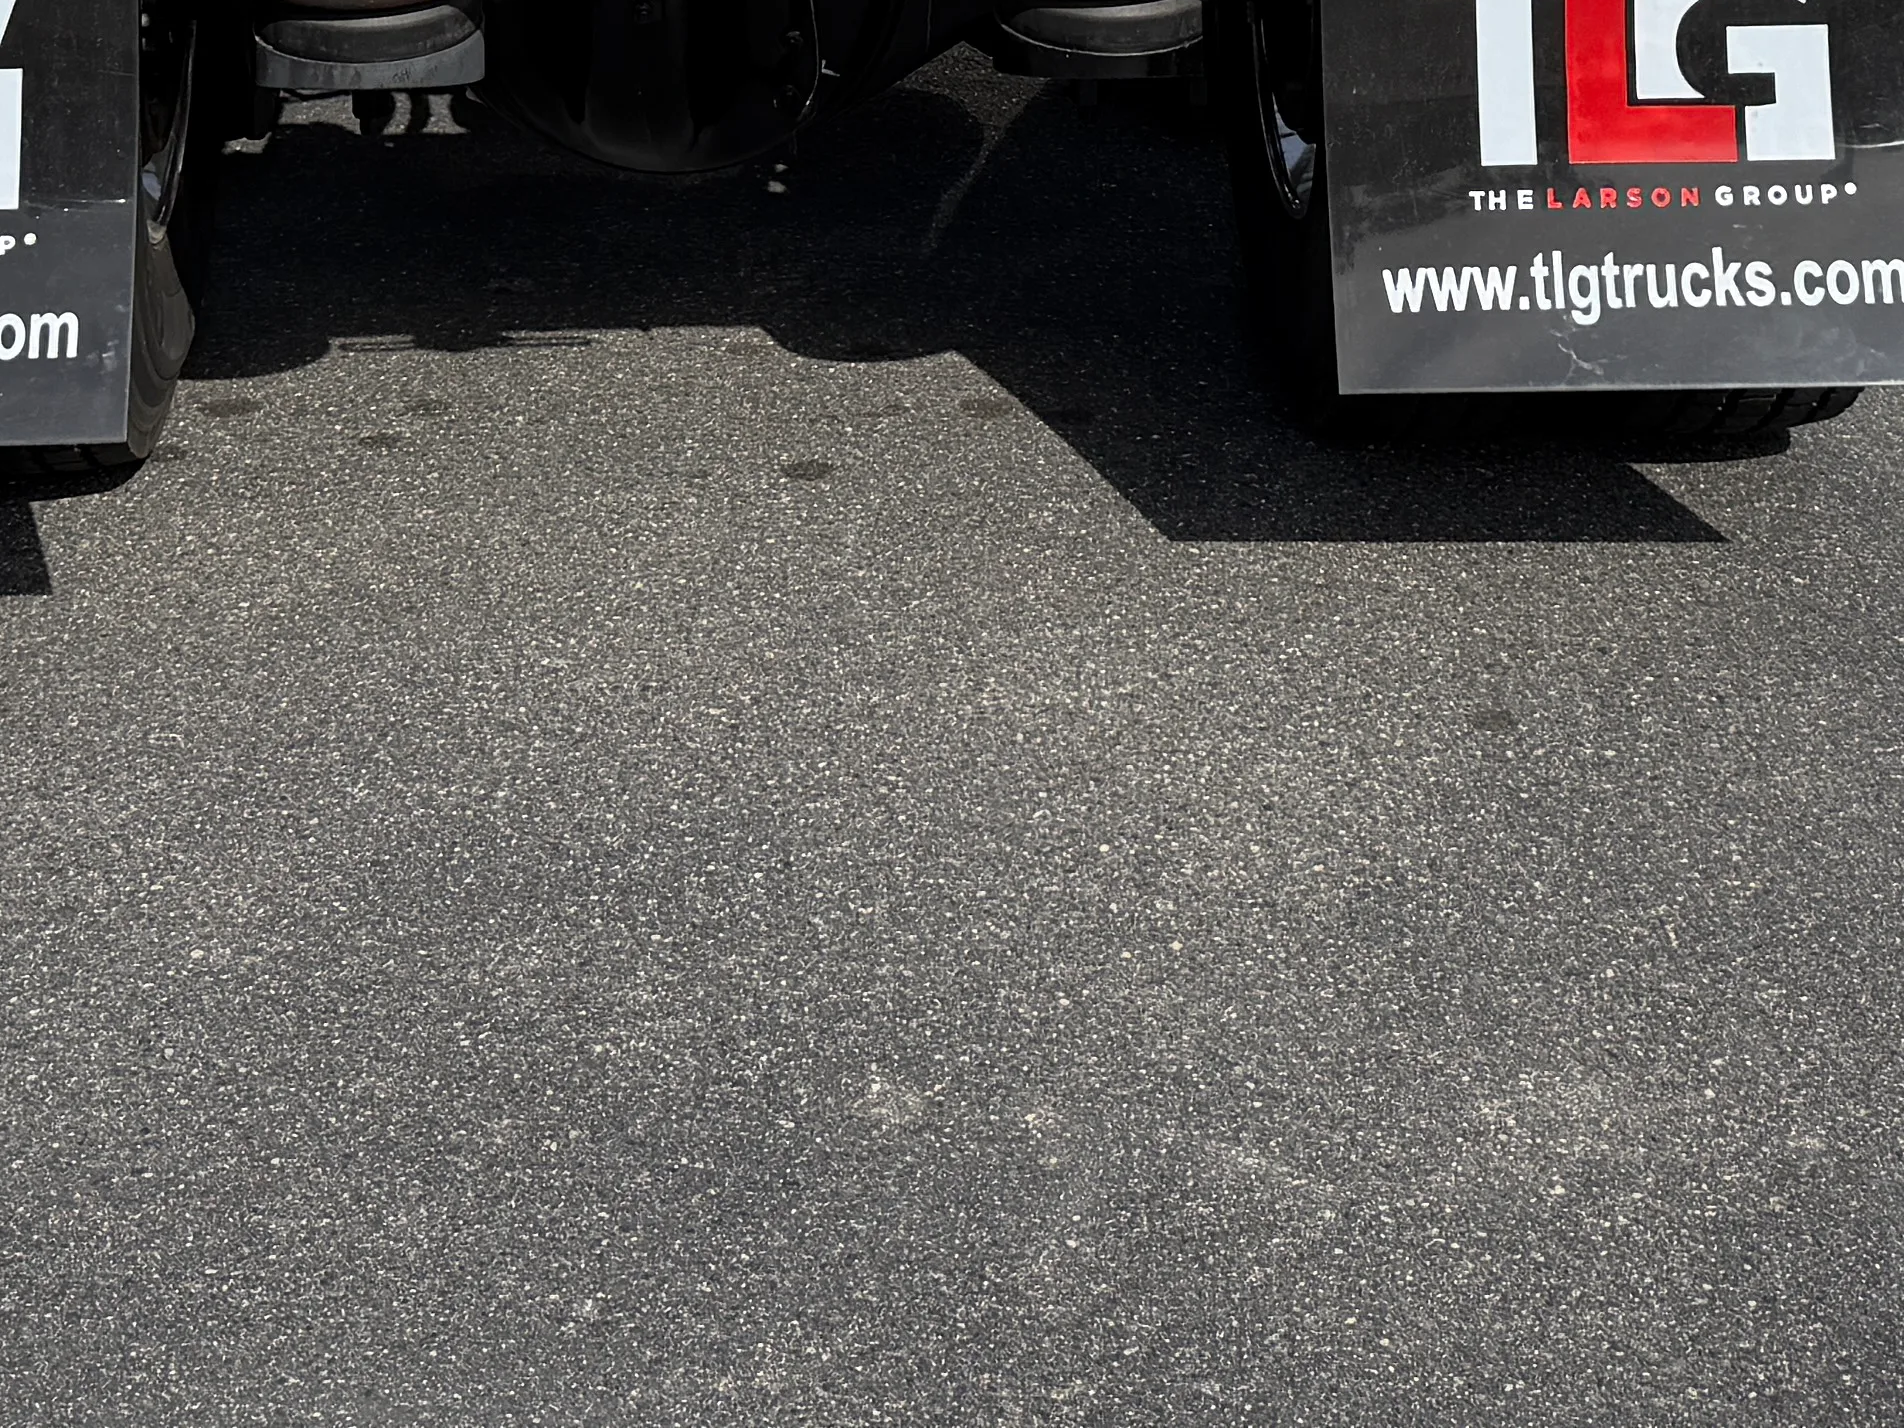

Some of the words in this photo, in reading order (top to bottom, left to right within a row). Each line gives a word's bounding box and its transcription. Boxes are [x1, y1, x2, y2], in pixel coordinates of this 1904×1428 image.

[1469, 189, 1535, 211] THE
[1546, 186, 1701, 210] LARSON
[1714, 184, 1839, 207] GROUP
